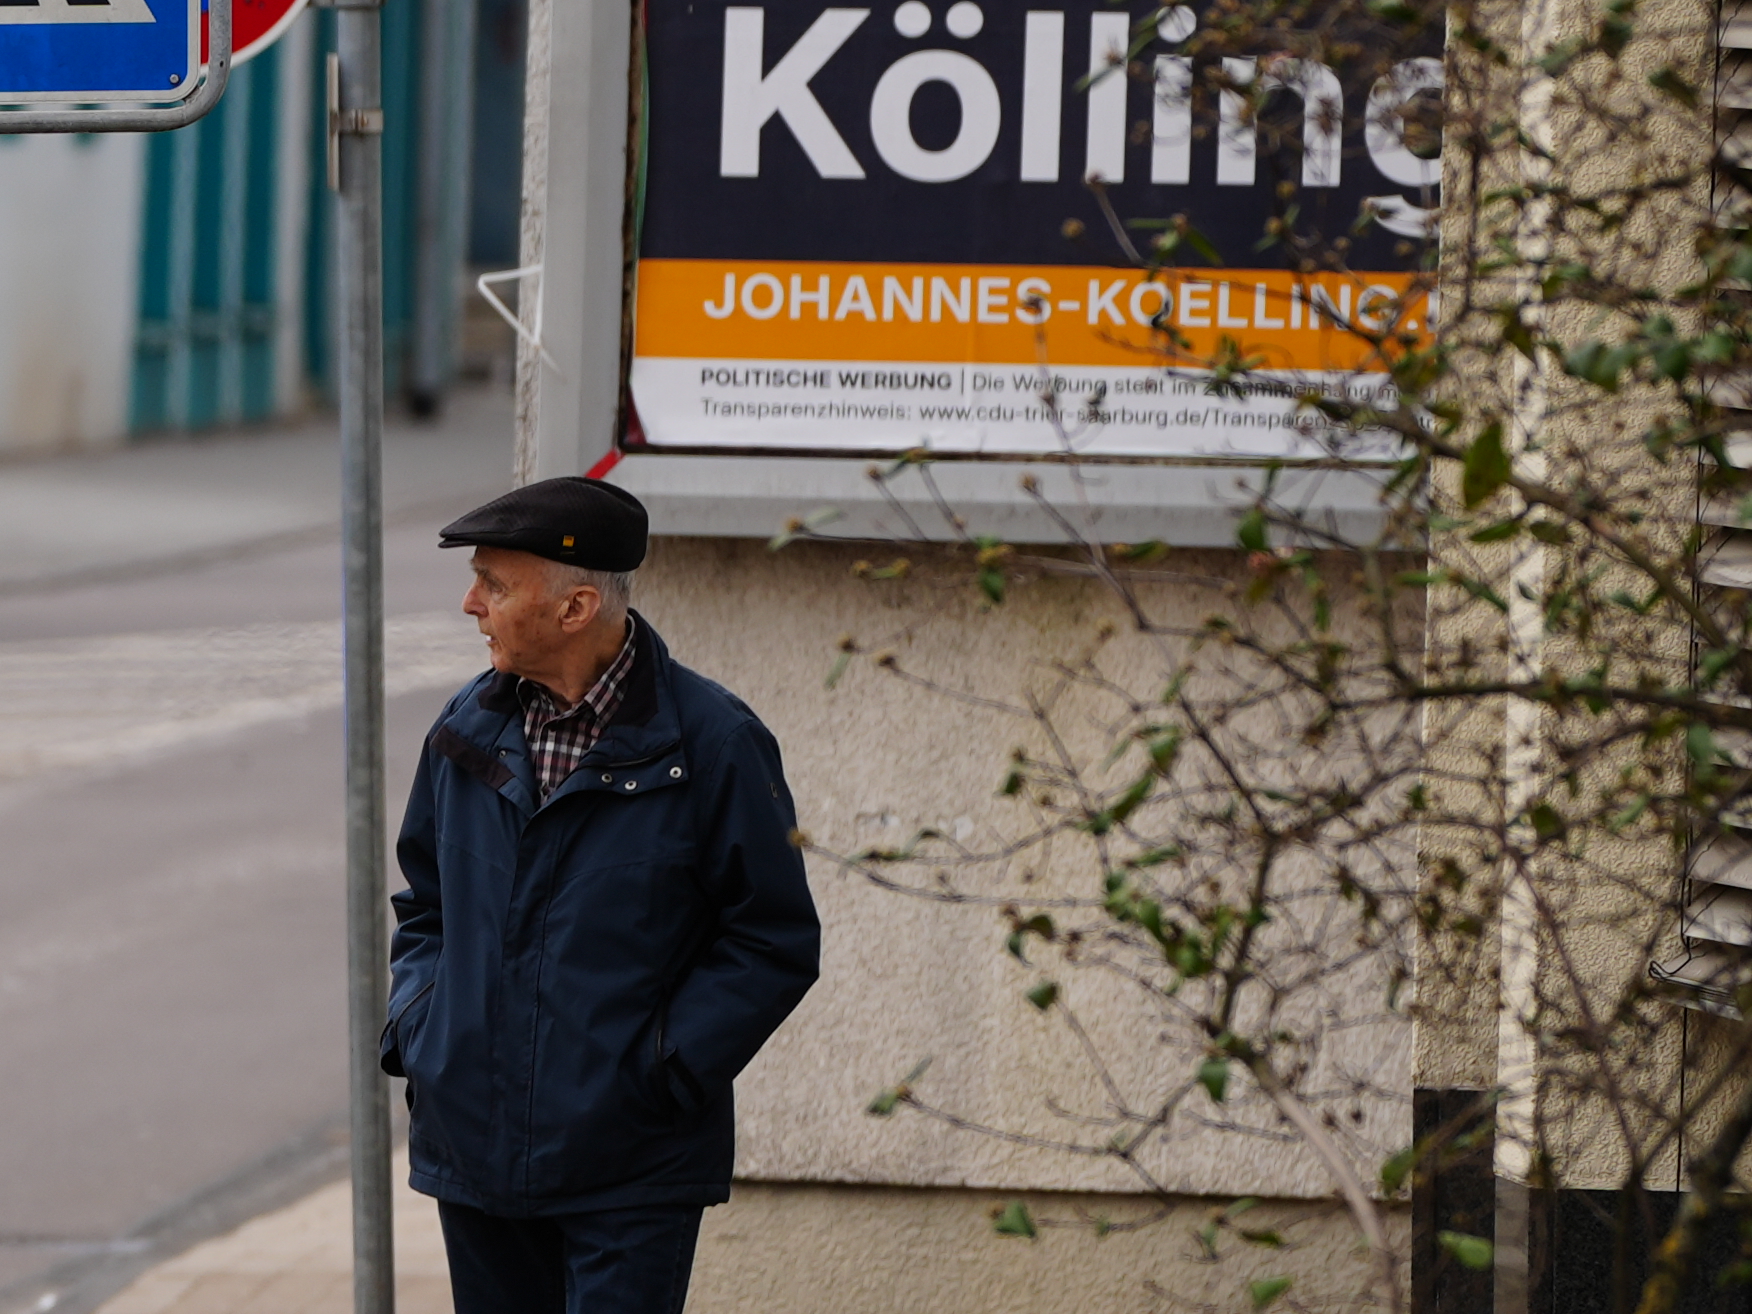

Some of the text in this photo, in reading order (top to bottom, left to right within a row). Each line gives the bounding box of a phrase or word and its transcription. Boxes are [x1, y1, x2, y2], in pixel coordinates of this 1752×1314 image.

[719, 0, 1443, 239] Kölling
[701, 367, 831, 390] POLITISCHE
[839, 369, 952, 392] WERBUNG
[973, 371, 1004, 391] Die
[1172, 375, 1197, 395] im
[701, 396, 911, 421] Transparenzhinweis:
